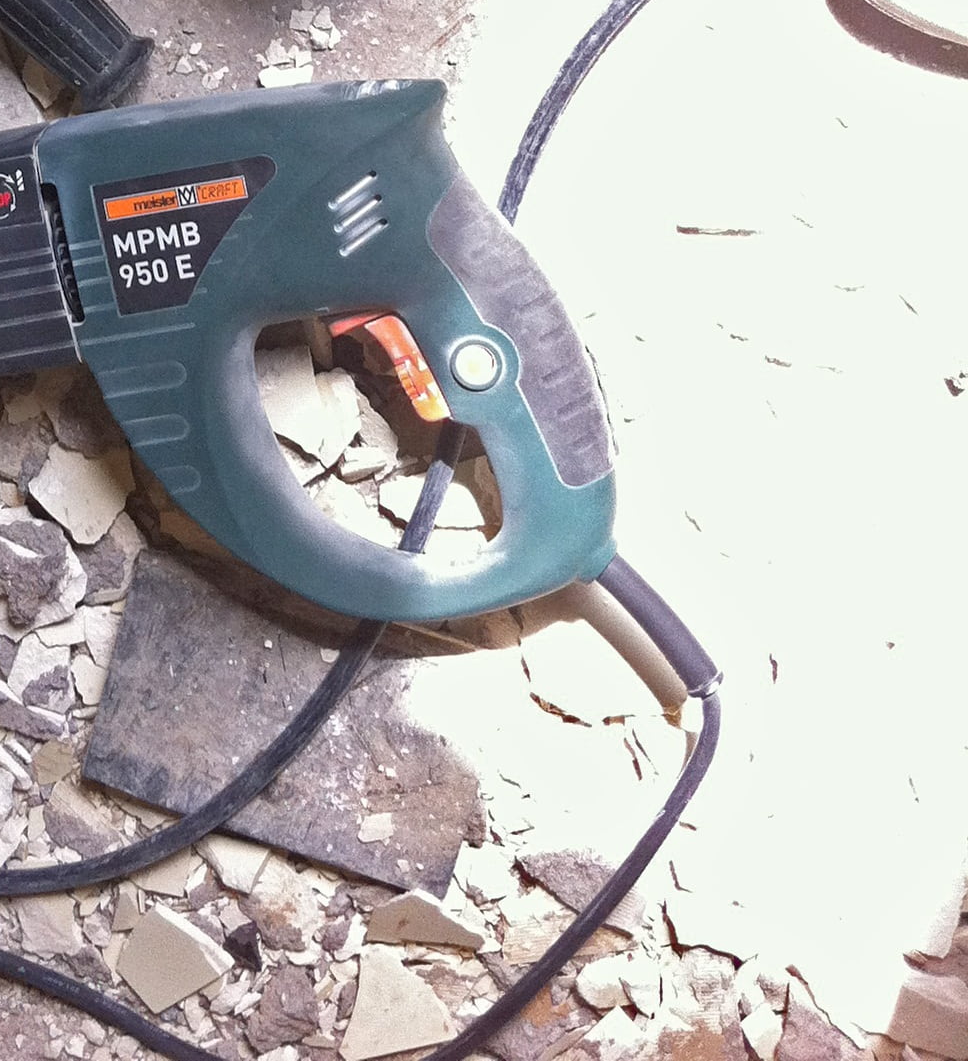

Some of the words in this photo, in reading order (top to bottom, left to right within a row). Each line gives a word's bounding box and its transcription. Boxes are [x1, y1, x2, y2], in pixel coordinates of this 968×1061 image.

[133, 196, 177, 212] meister
[201, 181, 238, 200] CRAFT
[112, 221, 201, 258] MPMB
[119, 258, 169, 288] 950
[175, 254, 196, 279] E
